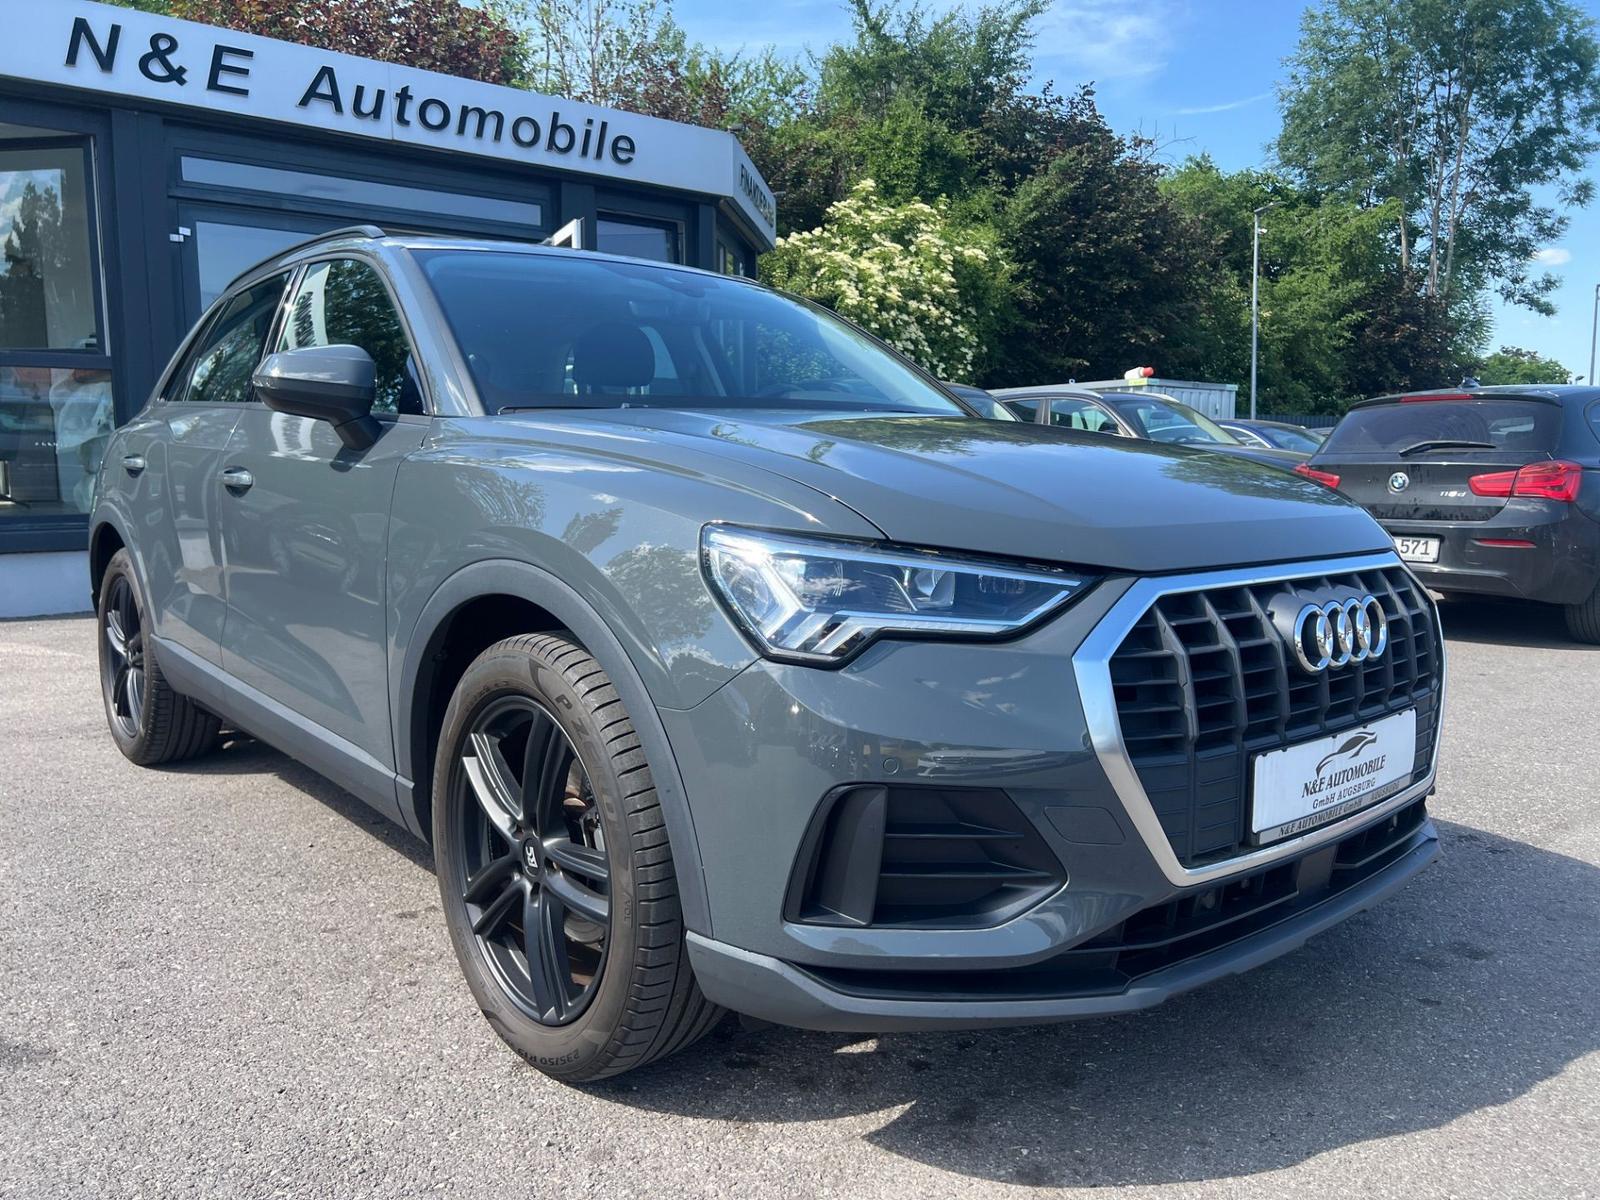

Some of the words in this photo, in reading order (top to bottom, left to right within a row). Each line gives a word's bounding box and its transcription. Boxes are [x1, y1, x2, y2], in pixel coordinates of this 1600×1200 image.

[297, 64, 636, 165] Automobile
[1400, 539, 1430, 555] 571
[1302, 776, 1326, 798] N&E
[1325, 755, 1385, 789] AUTOMOBILE
[1312, 792, 1336, 809] GmbH
[1337, 777, 1376, 800] AUGSBURG
[1297, 808, 1343, 830] AUTOMOBILE
